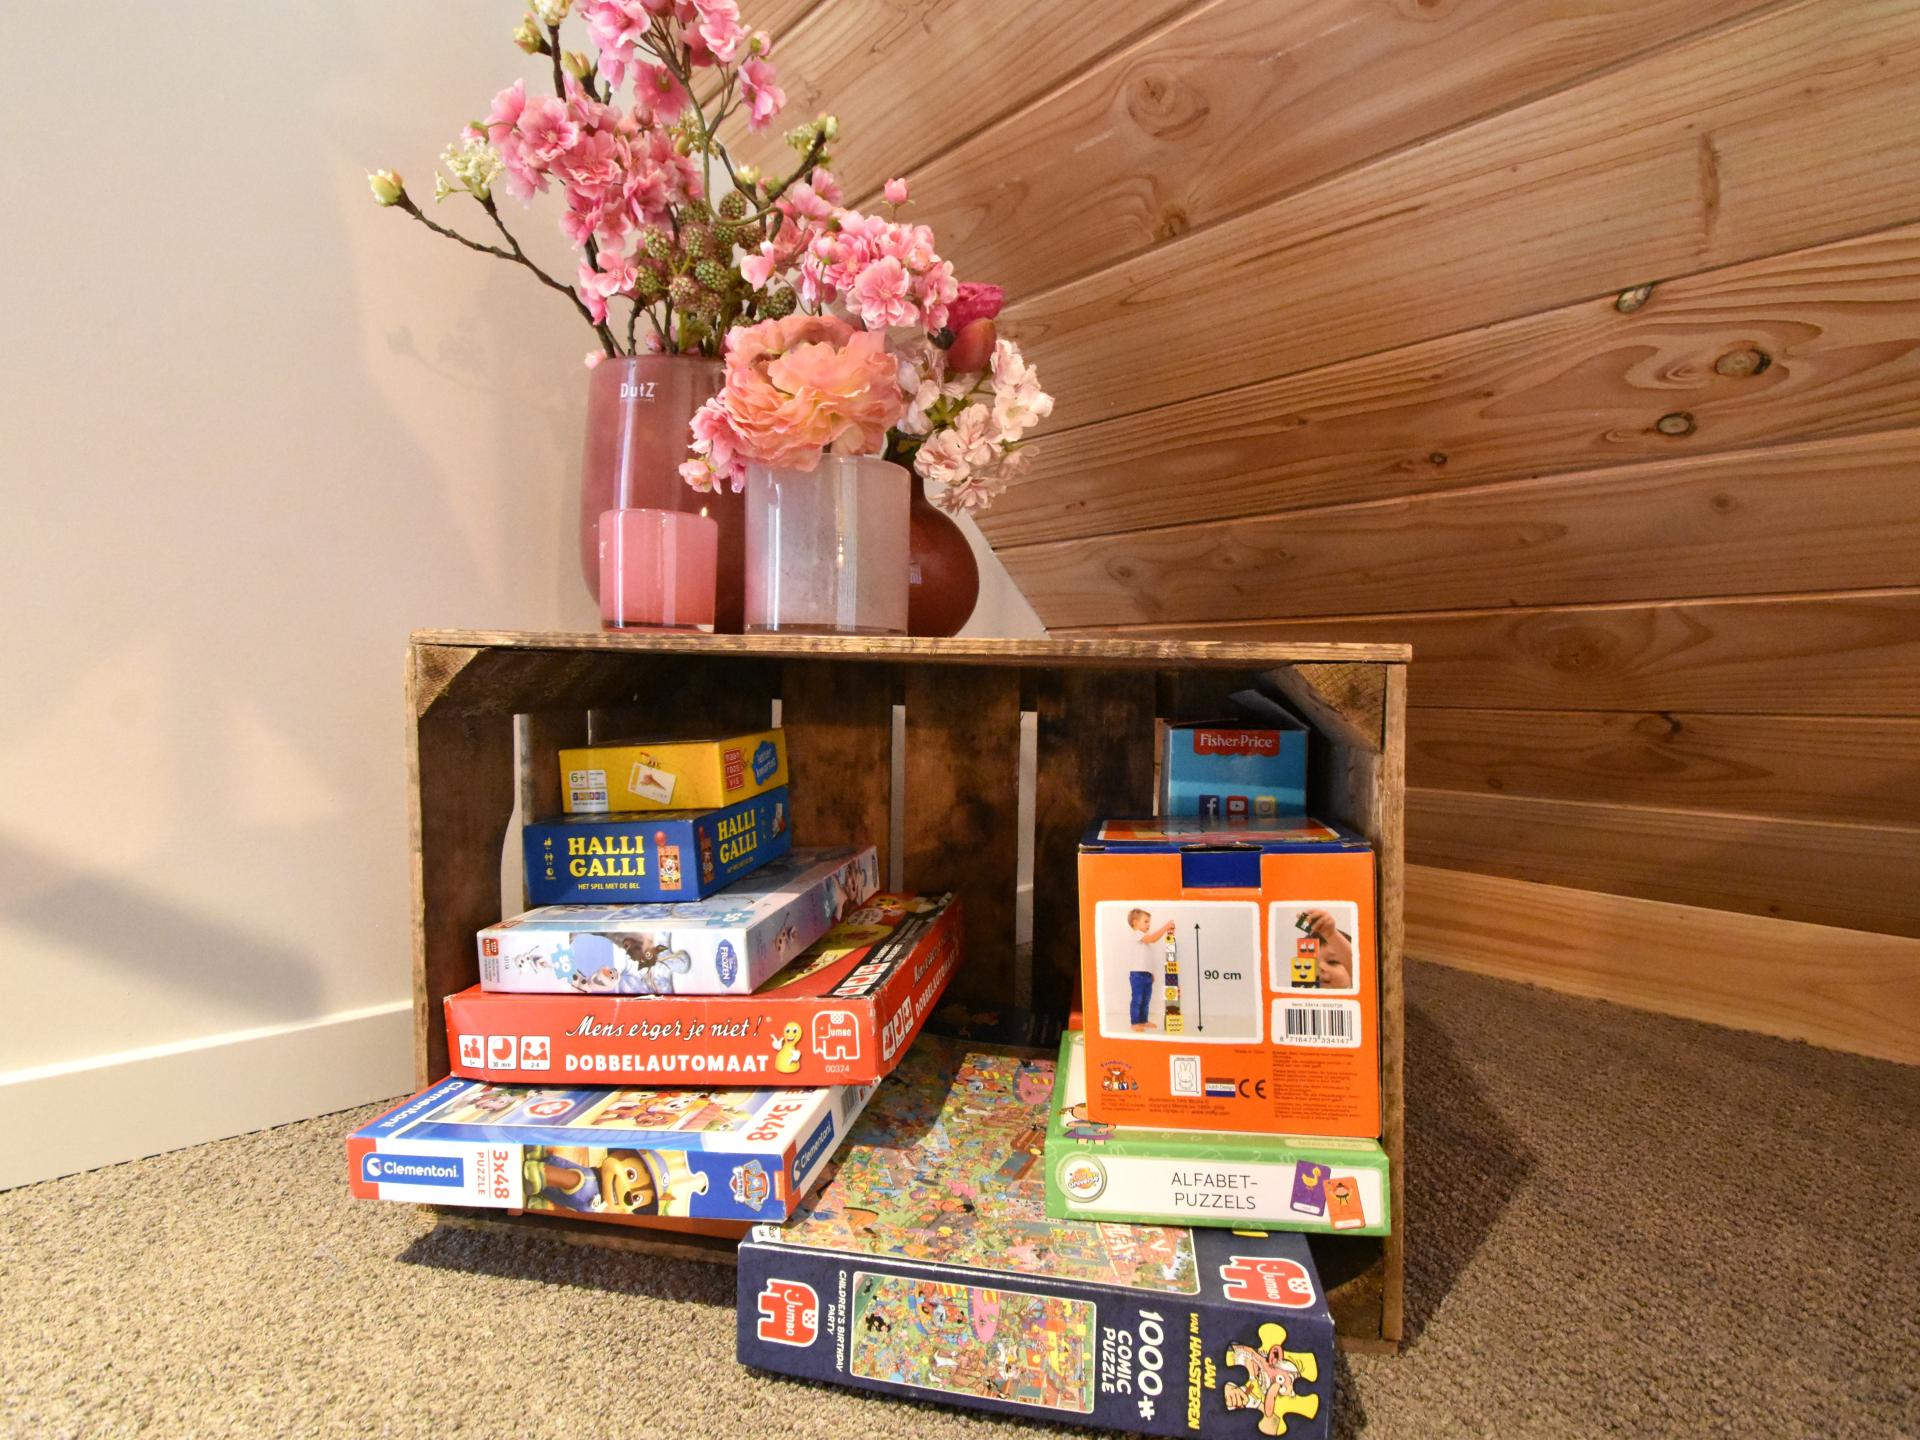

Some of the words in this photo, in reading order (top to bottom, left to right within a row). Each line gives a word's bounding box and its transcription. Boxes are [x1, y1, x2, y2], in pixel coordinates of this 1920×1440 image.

[718, 809, 756, 842] HALLI
[568, 835, 645, 855] HALLI
[719, 831, 758, 864] GALLI
[569, 857, 646, 877] GALLI
[719, 946, 731, 980] FROZEN
[1204, 969, 1220, 981] 90
[1223, 972, 1242, 981] cm
[565, 1015, 623, 1037] Mens
[626, 1018, 682, 1041] erger
[684, 1019, 705, 1041] je
[565, 1054, 769, 1072] DOBBELAUTOMAAT
[825, 1064, 850, 1073] 00374
[378, 1081, 465, 1128] Clementoni
[745, 1103, 802, 1142] 3x48
[800, 1124, 833, 1169] Clementoni
[383, 1161, 458, 1178] Clementoni
[476, 1151, 486, 1196] PUZZLE
[492, 1150, 510, 1200] 3x48
[1171, 1172, 1259, 1190] ALFABET-
[1175, 1192, 1257, 1211] PUZZELS
[837, 1270, 847, 1325] CHILDREN'S
[826, 1303, 836, 1336] PARTY
[1188, 1311, 1200, 1335] VAN
[835, 1325, 847, 1372] BIRTHDAY
[1101, 1326, 1117, 1394] PUZZLE
[1117, 1329, 1133, 1395] COMIC
[1186, 1335, 1202, 1431] HAASTEREN
[1203, 1356, 1217, 1390] JAN
